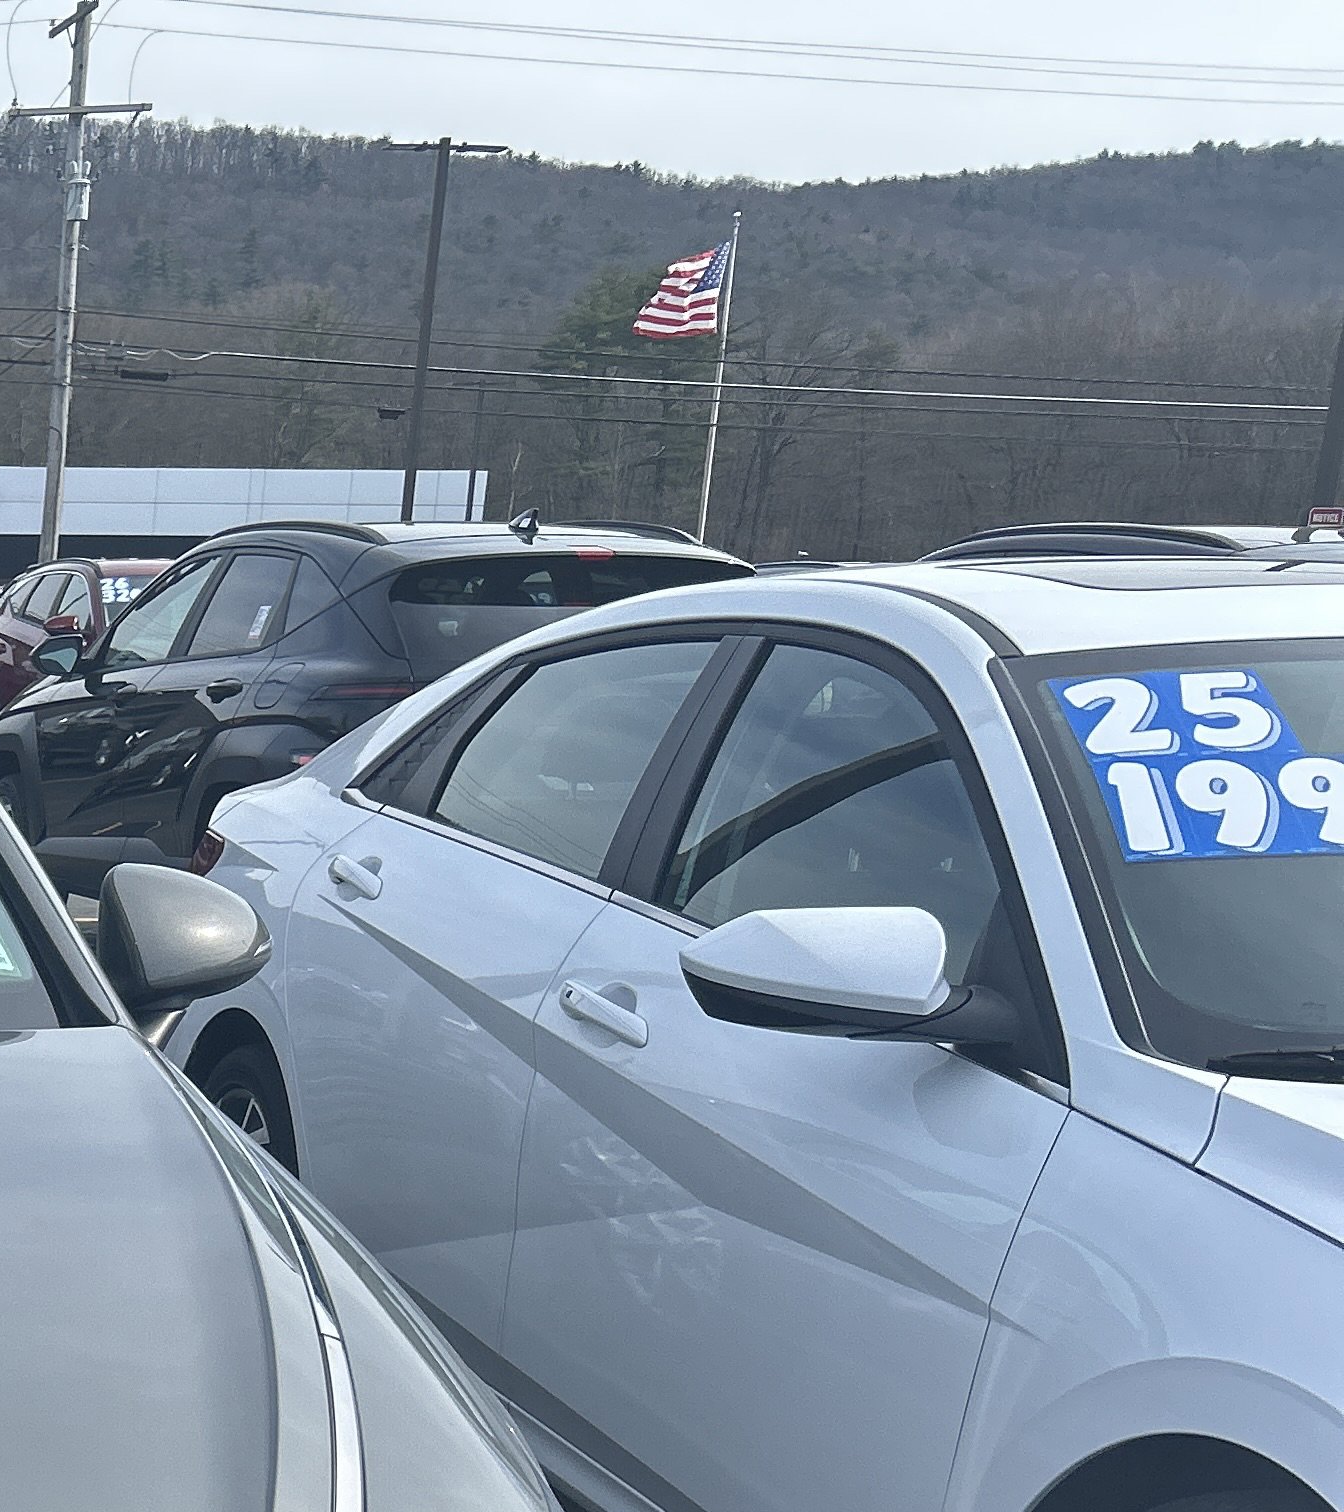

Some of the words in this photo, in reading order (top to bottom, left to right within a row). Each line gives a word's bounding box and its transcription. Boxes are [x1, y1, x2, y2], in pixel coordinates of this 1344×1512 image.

[100, 578, 129, 590] 26
[1063, 671, 1282, 757] 25
[1107, 757, 1344, 855] 199
